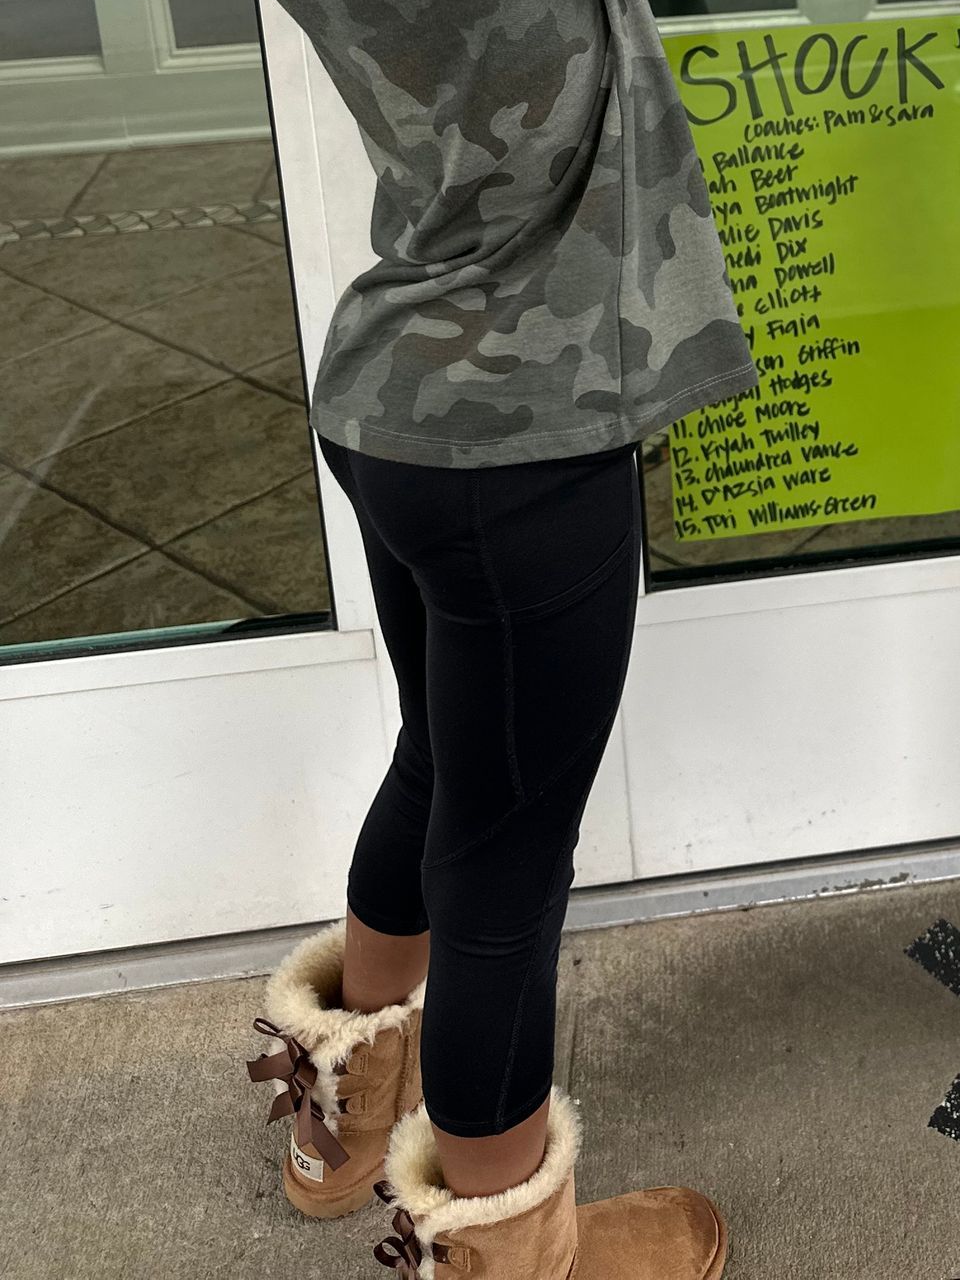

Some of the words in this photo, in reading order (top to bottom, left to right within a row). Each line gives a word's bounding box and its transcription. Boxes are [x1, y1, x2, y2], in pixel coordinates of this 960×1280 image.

[680, 27, 945, 126] SHOCK
[776, 238, 808, 264] Dix
[769, 369, 833, 397] Hodges
[675, 469, 701, 490] 13.
[675, 494, 699, 516] 14.
[674, 520, 702, 538] 15.
